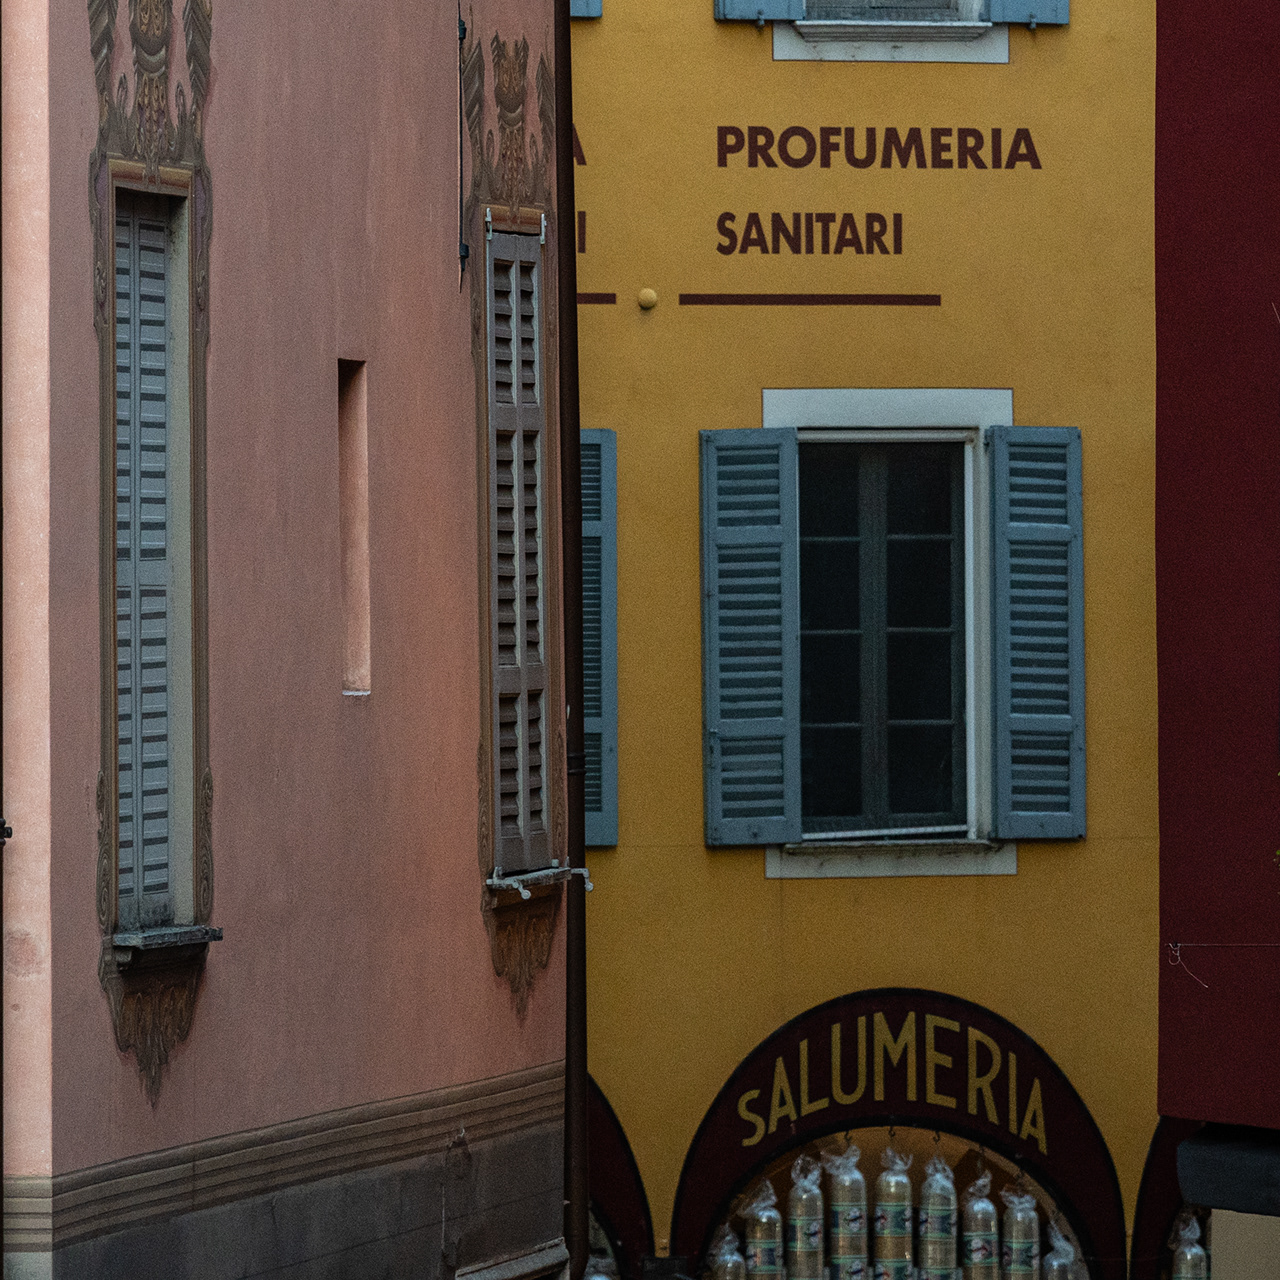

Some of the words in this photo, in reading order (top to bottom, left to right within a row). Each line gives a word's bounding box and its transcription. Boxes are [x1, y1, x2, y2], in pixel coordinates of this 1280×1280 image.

[716, 126, 1043, 170] PROFUMERIA
[715, 211, 903, 255] SANITARI
[737, 1010, 1049, 1156] SALUMERIA
